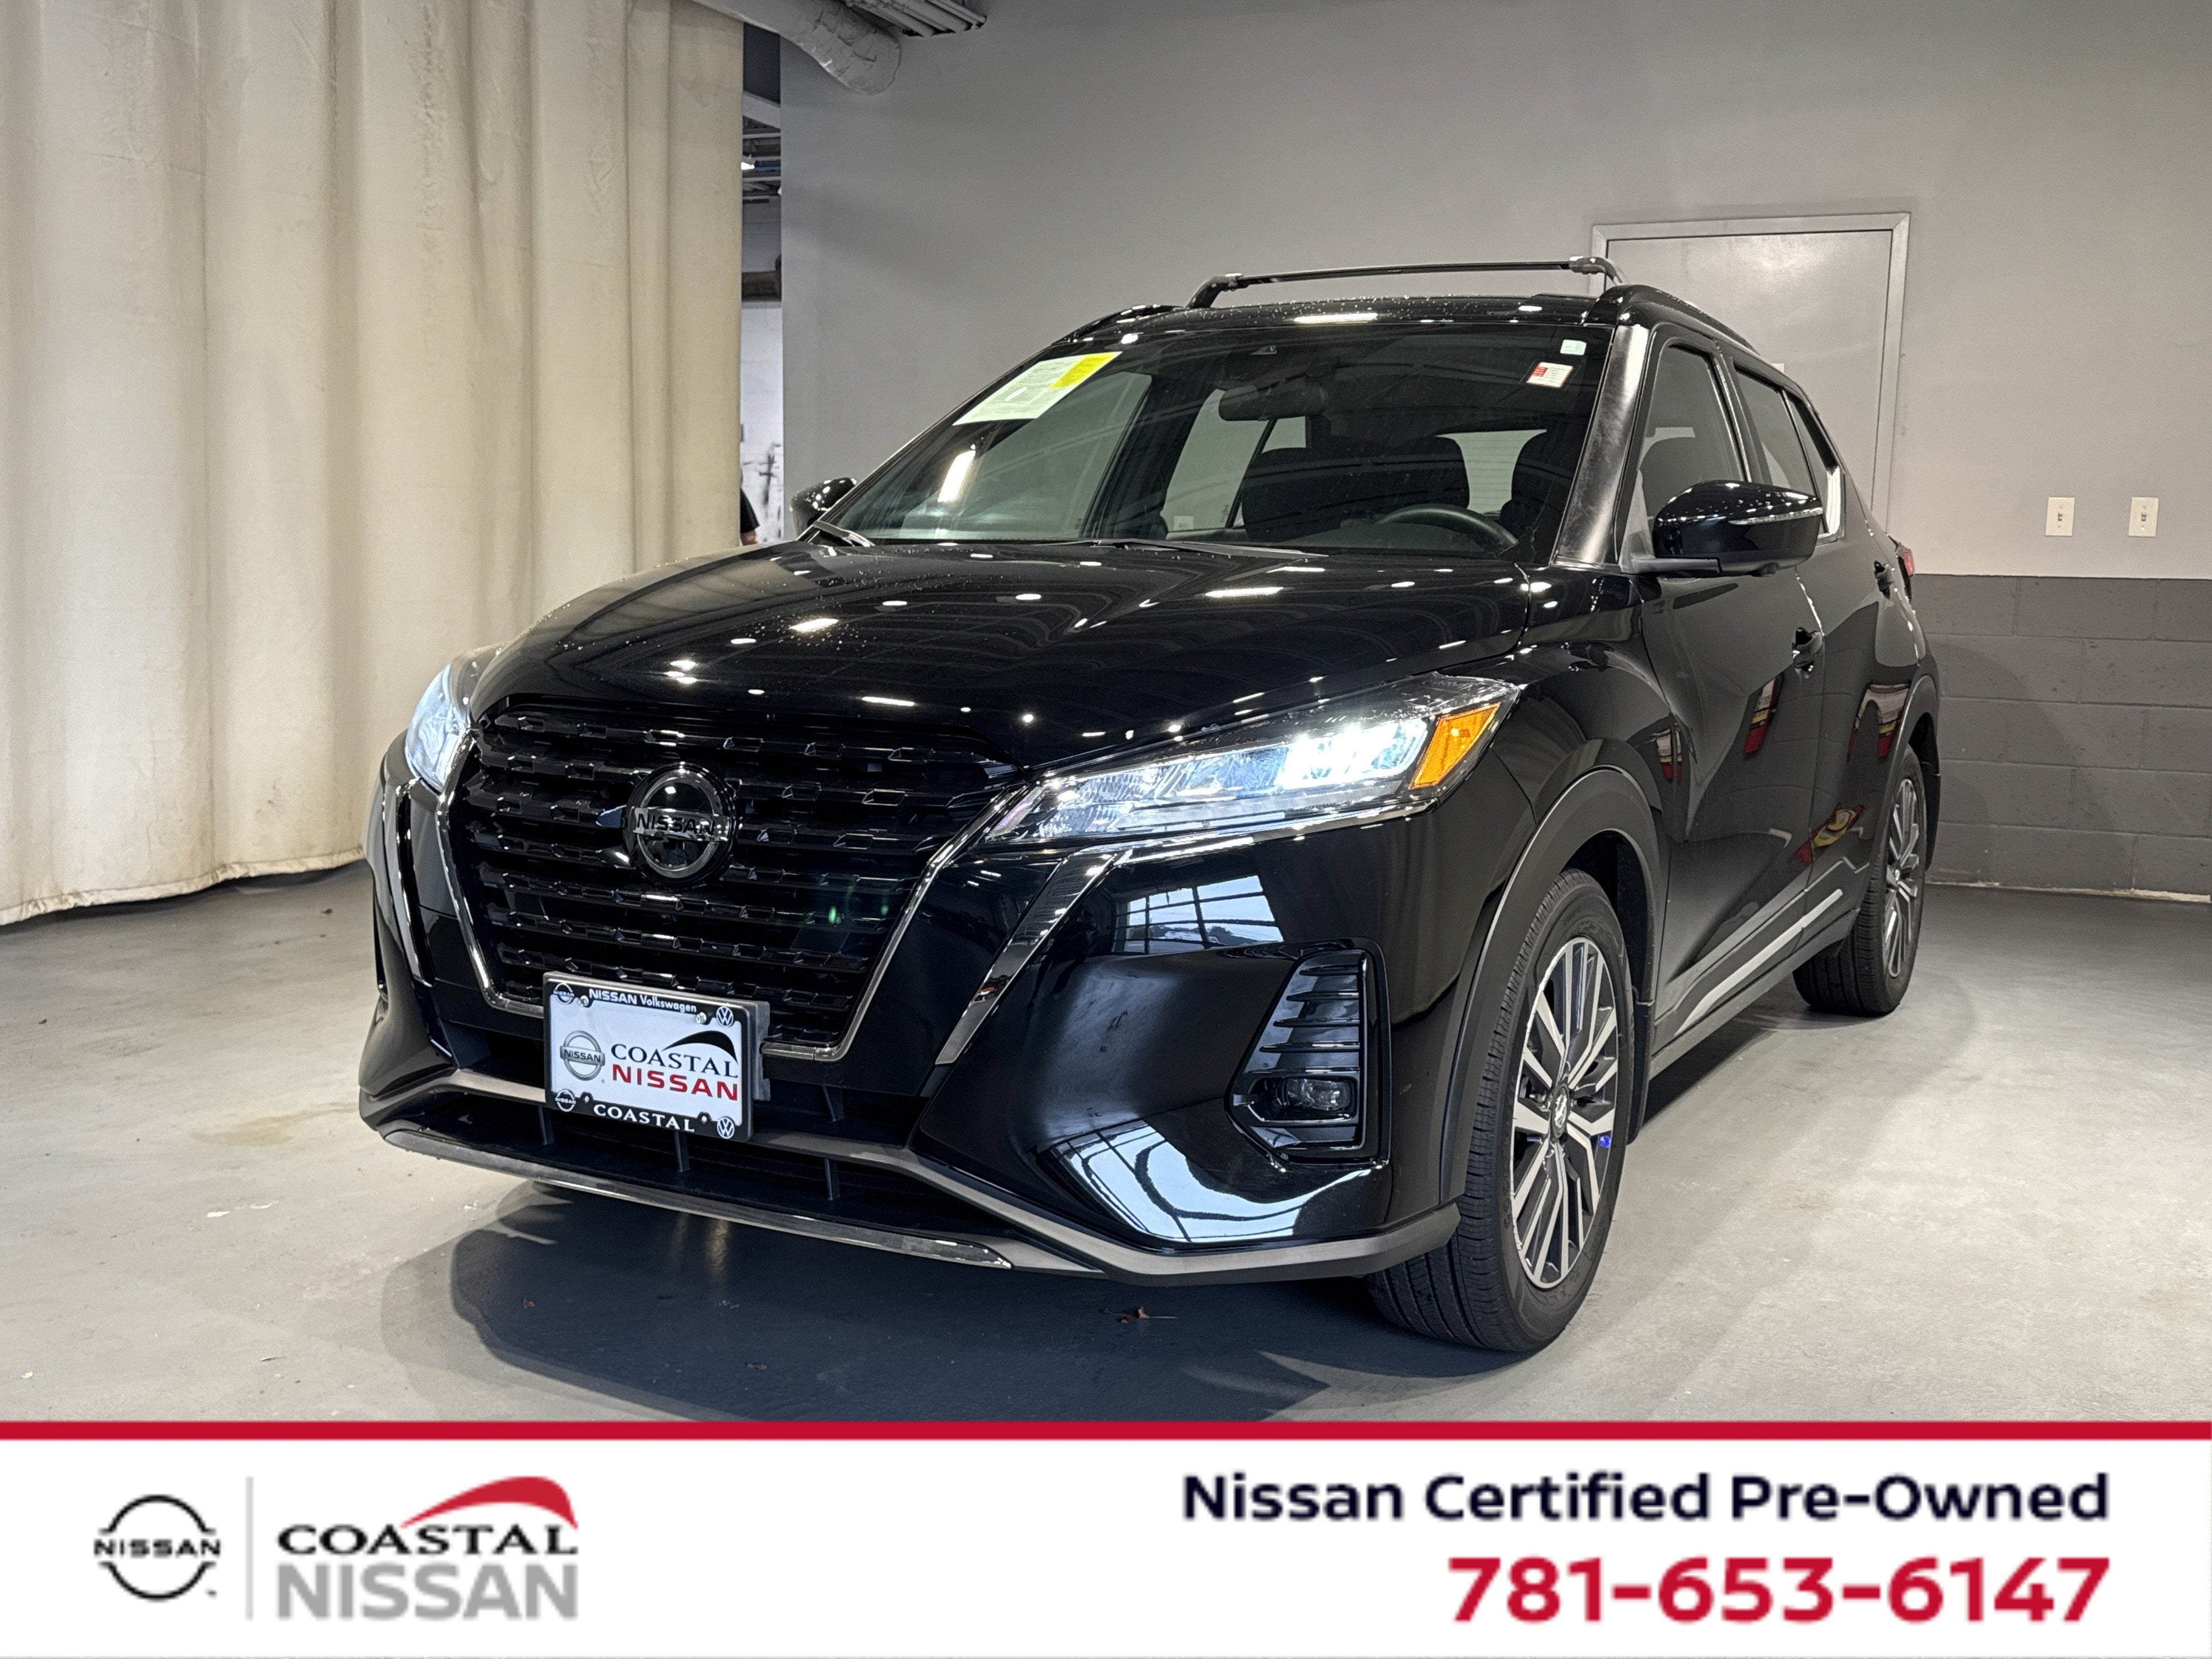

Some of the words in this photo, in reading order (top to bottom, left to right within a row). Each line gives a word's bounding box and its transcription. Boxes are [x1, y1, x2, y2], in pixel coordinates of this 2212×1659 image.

[637, 813, 716, 836] NISSAN
[589, 988, 637, 1005] NISSAN
[640, 994, 697, 1014] Volkswagen
[564, 1049, 601, 1063] NISSAN
[611, 1043, 738, 1079] COASTAL
[612, 1064, 738, 1102] NISSAN
[594, 1103, 695, 1133] COASTAL
